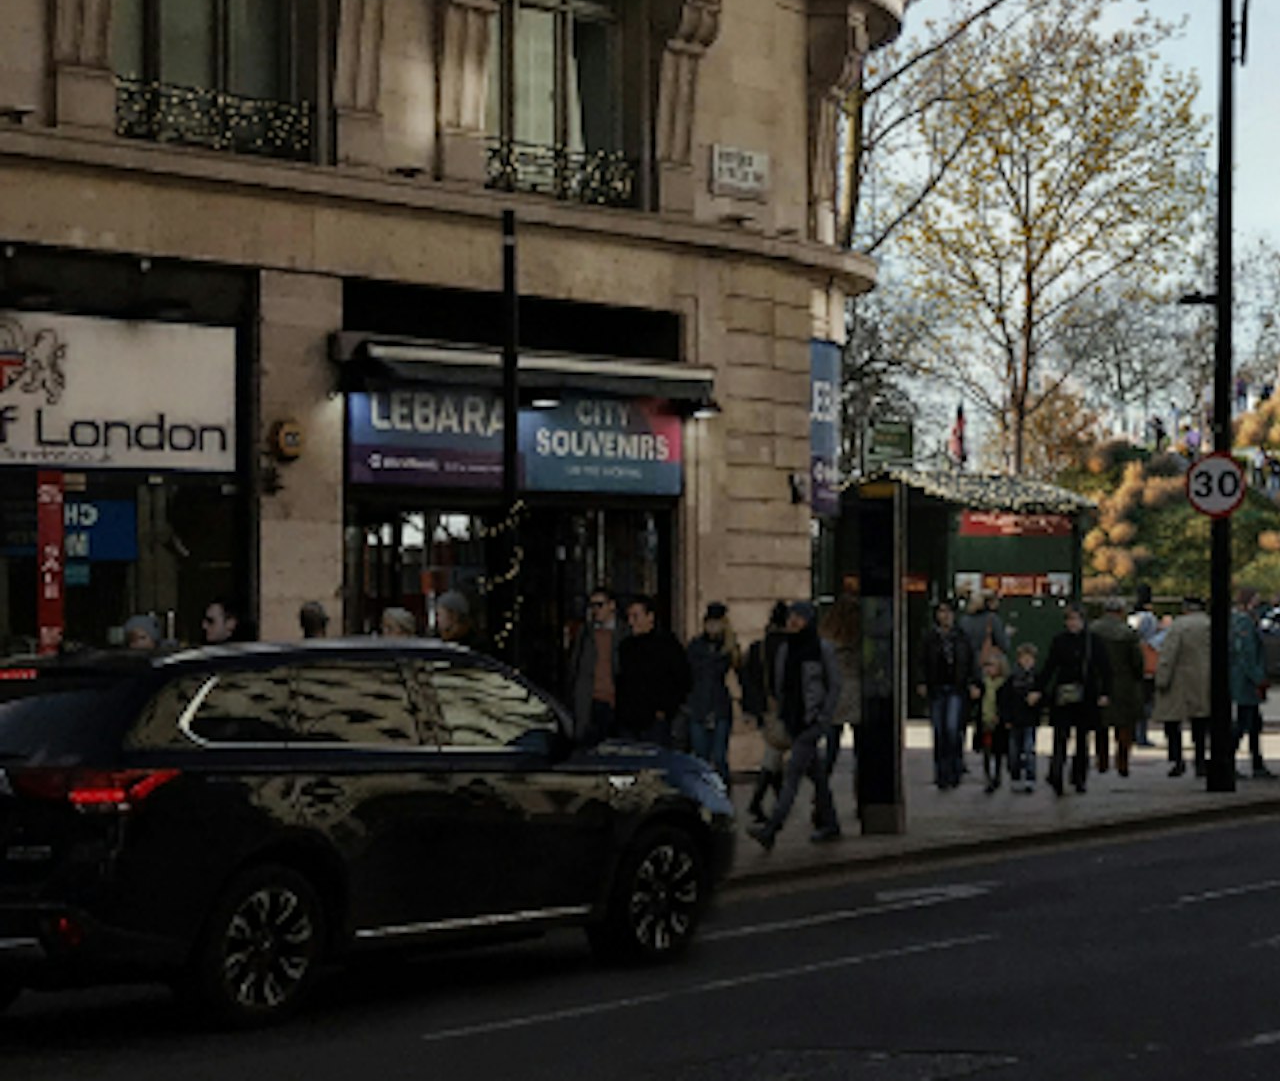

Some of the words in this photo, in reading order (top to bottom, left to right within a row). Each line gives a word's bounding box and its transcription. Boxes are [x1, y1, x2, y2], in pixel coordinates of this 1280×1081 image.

[575, 400, 632, 426] CITY
[36, 408, 227, 452] London
[536, 428, 671, 463] SOUVENIRS
[1194, 471, 1239, 497] 30
